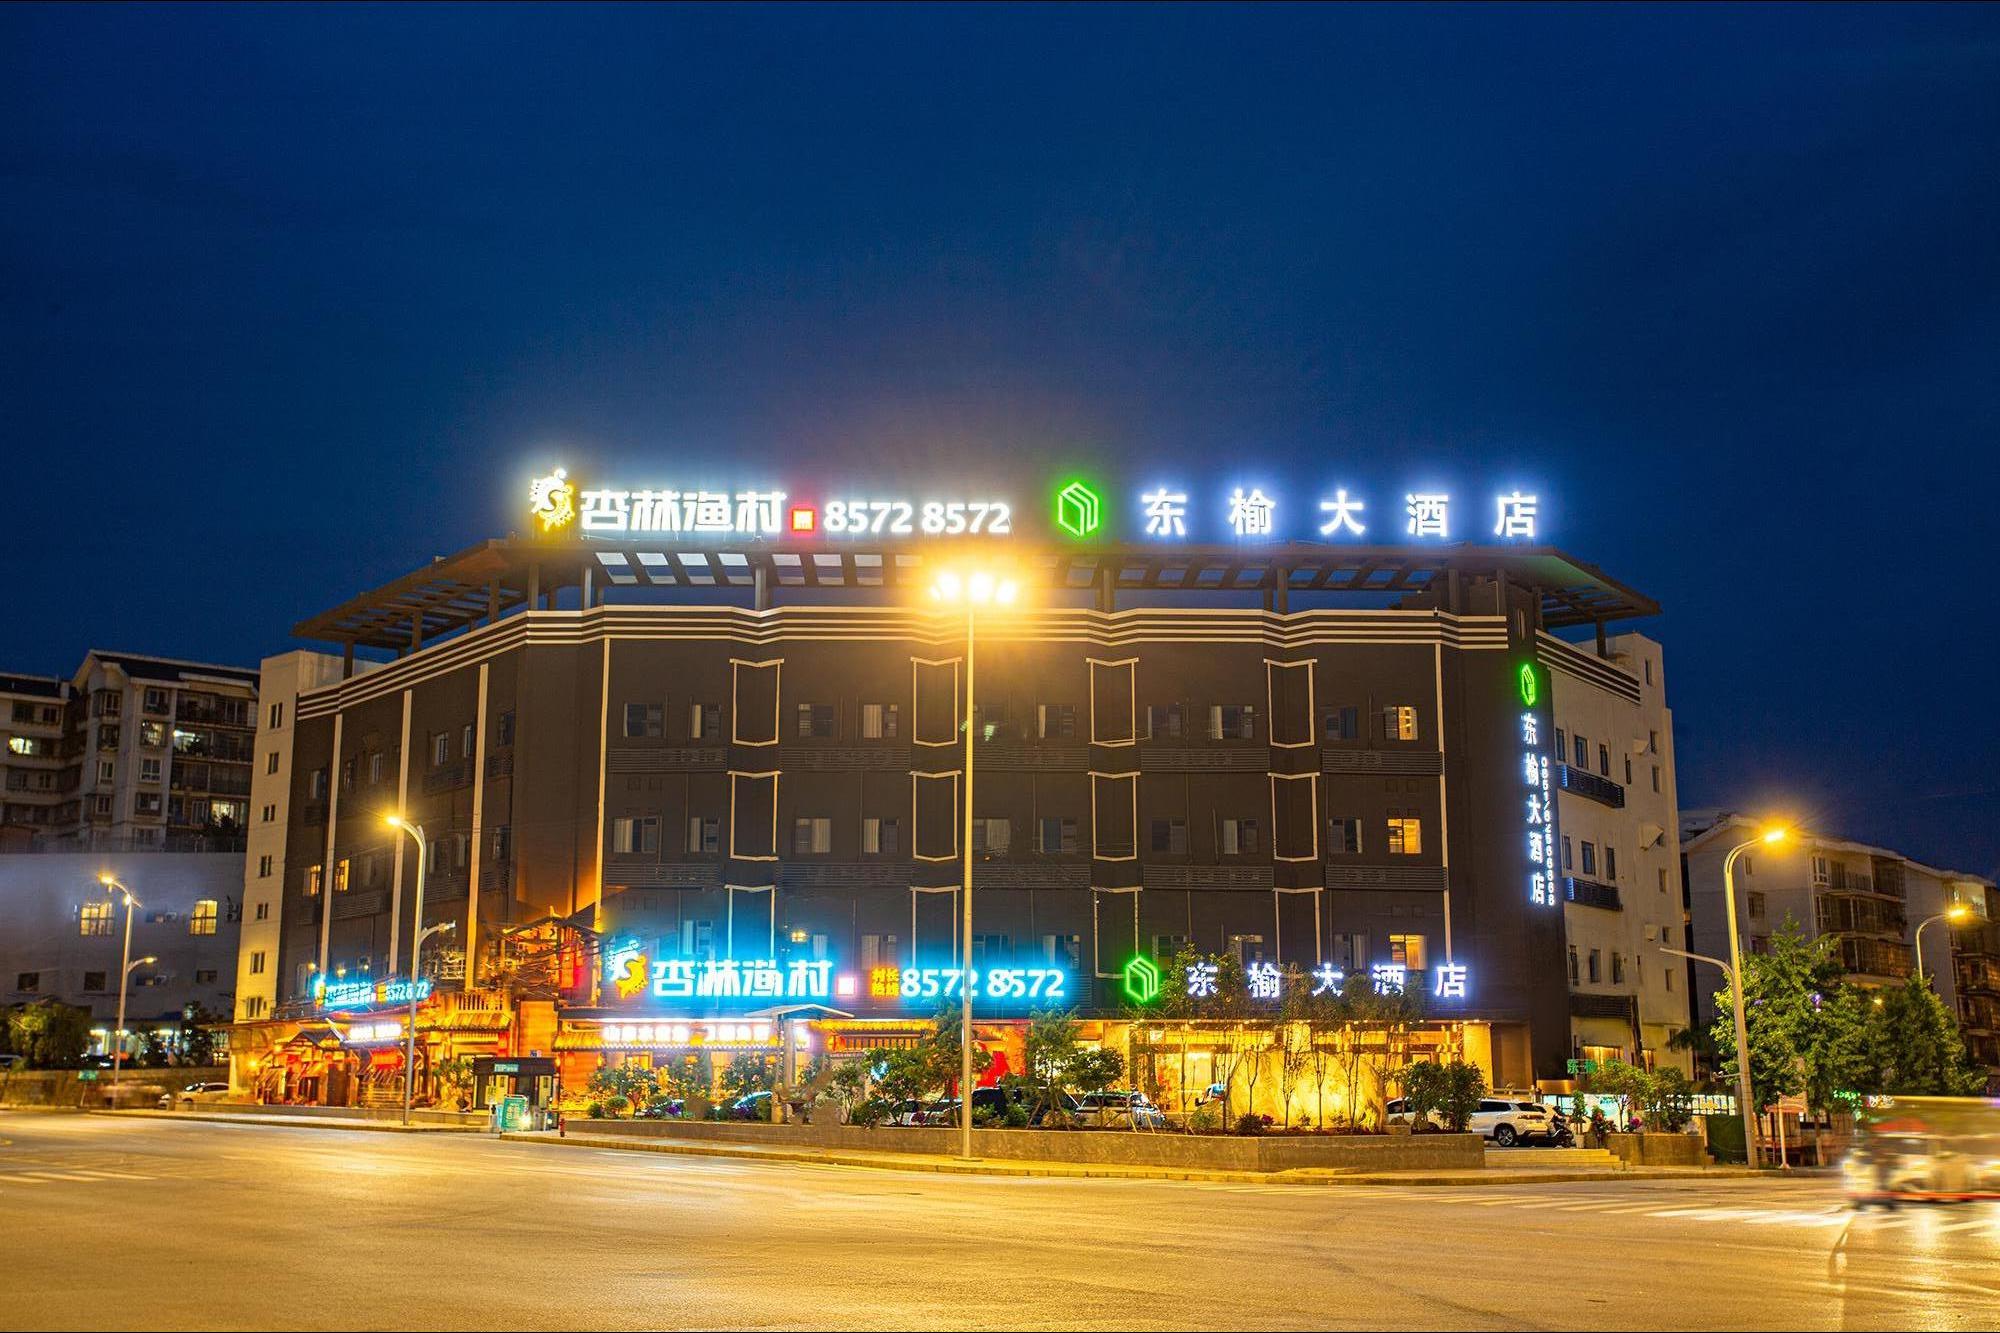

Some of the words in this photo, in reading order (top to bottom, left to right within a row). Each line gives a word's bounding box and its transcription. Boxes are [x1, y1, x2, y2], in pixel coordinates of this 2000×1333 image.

[580, 489, 788, 533] 杏林渔村
[824, 501, 911, 533] 8572
[922, 501, 1011, 533] 8572
[1141, 487, 1538, 537] 东榆大酒店
[1521, 712, 1545, 905] 东榆大酒店
[651, 959, 834, 997] 杏林渔村
[900, 968, 979, 998] 8572
[987, 968, 1065, 998] 8572
[1186, 962, 1467, 998] 东榆大酒店
